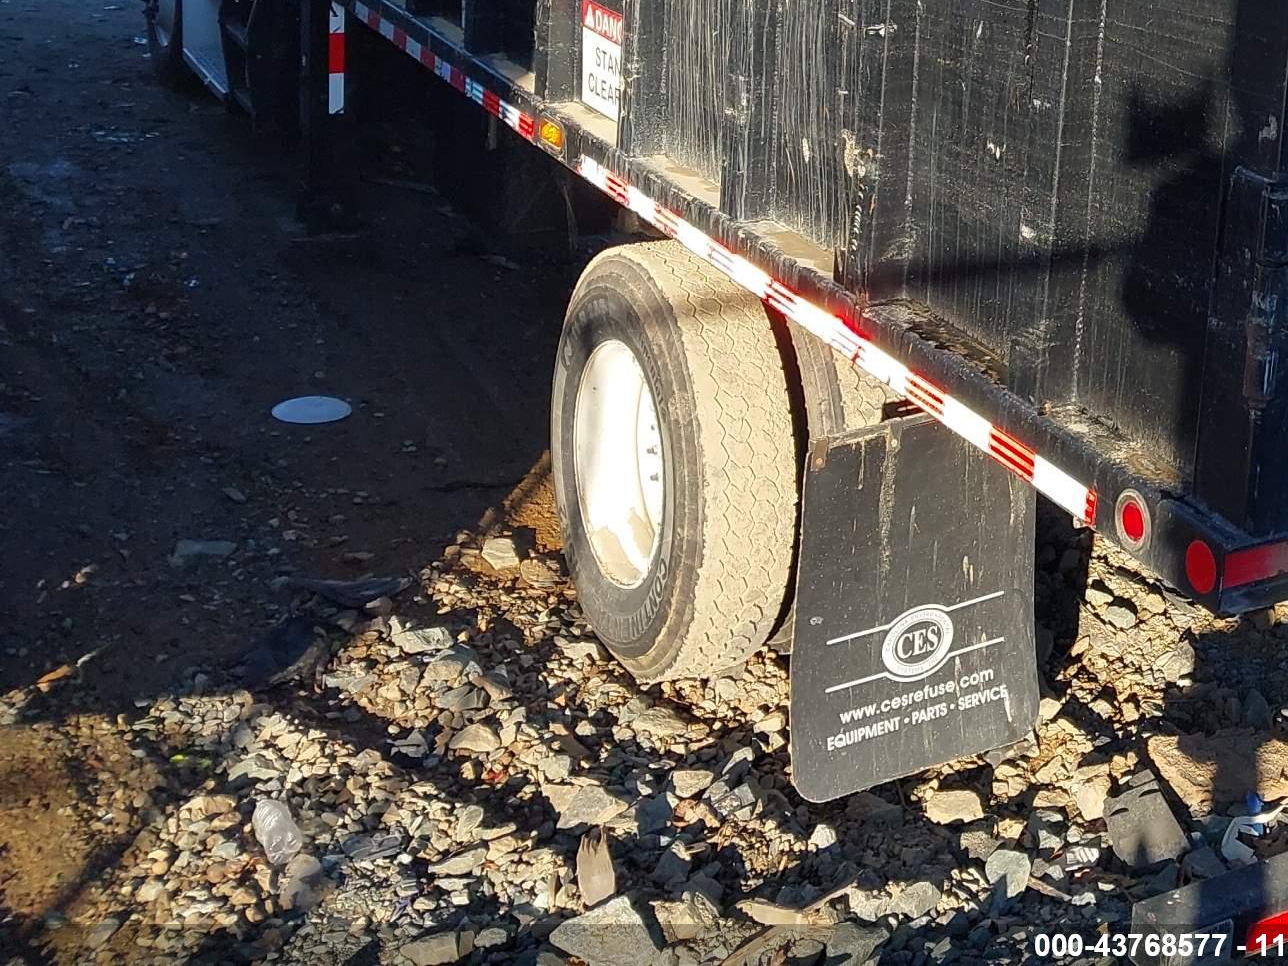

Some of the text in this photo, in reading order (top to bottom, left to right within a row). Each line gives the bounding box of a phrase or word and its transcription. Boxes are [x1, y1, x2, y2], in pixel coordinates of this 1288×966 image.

[595, 9, 623, 42] DAN
[595, 47, 621, 78] STAN
[897, 625, 939, 659] CES
[839, 668, 994, 724] www.cesrefuse.com
[827, 684, 1008, 751] EQUIPMENT PARTS SERVICE
